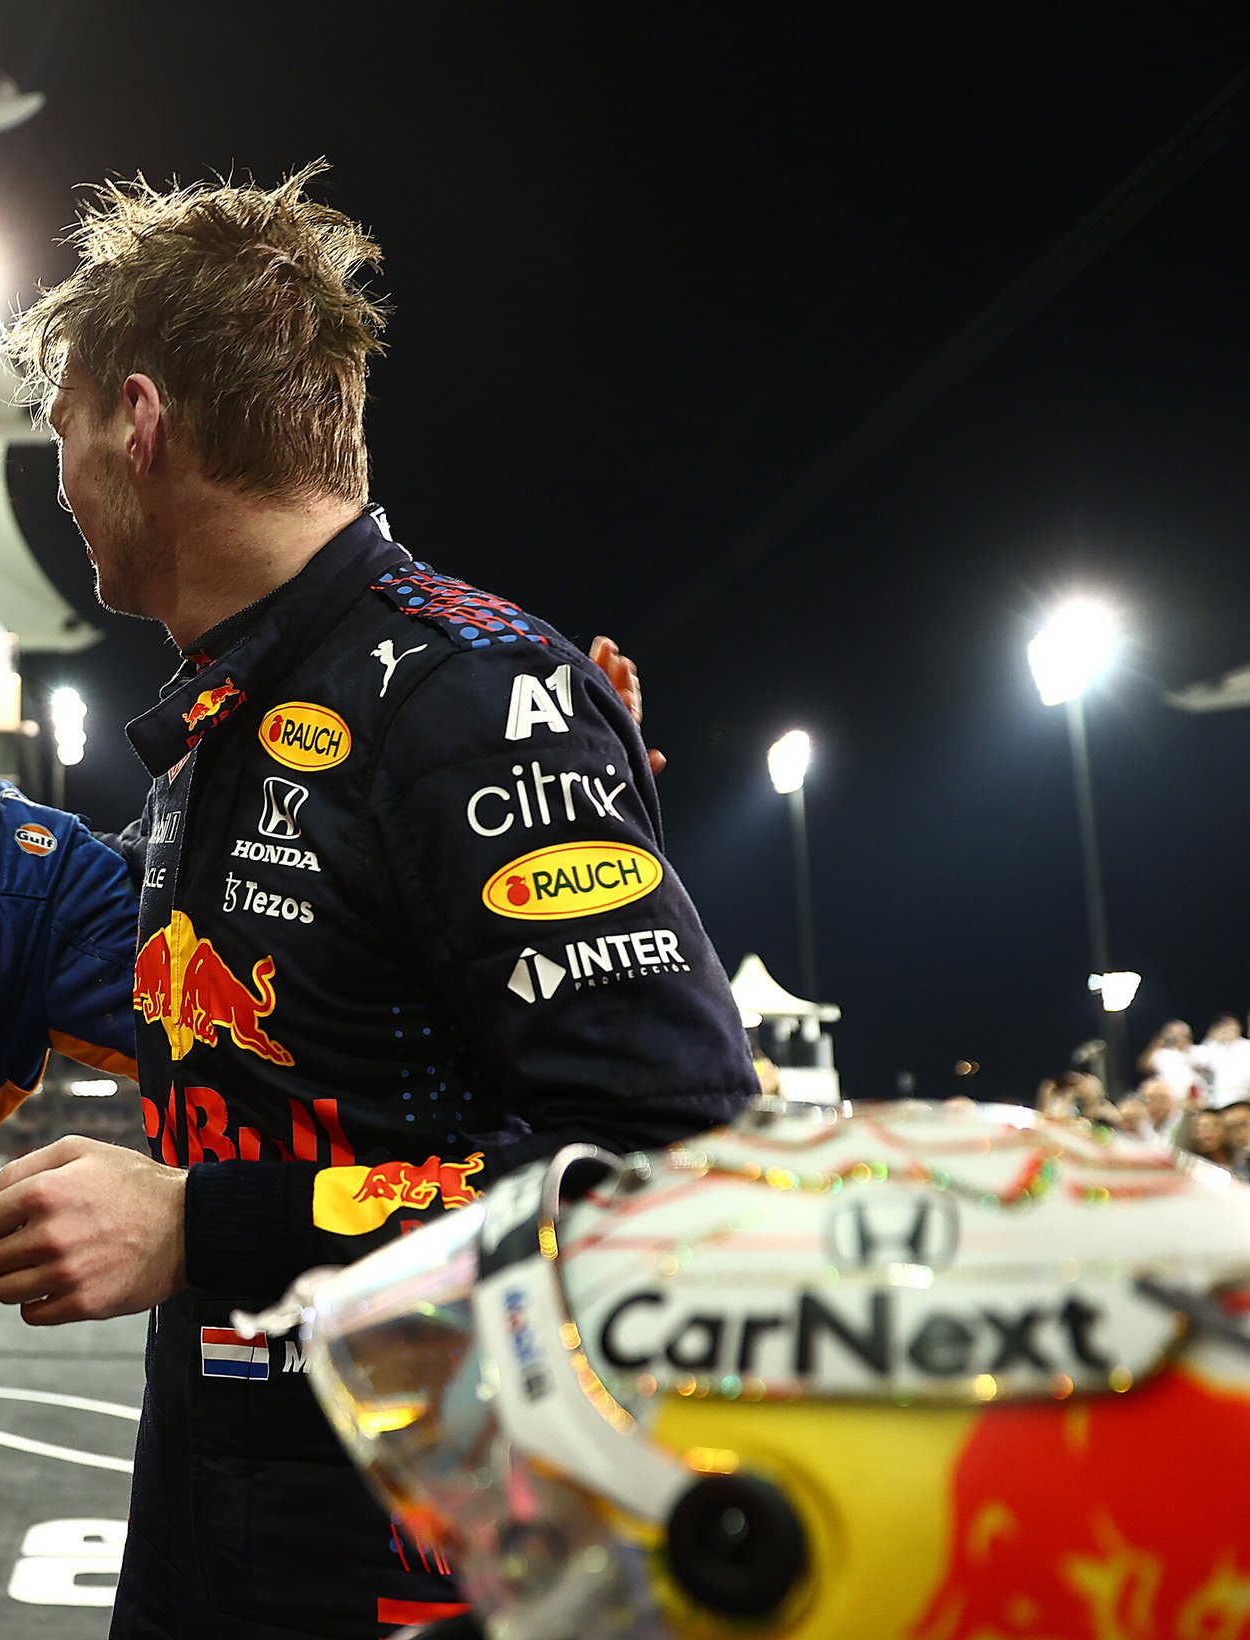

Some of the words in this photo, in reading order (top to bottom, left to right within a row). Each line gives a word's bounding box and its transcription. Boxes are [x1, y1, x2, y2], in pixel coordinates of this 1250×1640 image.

[505, 664, 574, 740] A1
[281, 719, 343, 757] RAUCH
[467, 761, 626, 837] citrix
[16, 830, 53, 849] Gulf
[231, 840, 321, 872] HONDA
[533, 858, 642, 900] RAUCH
[243, 881, 314, 924] Tezos
[565, 929, 686, 979] INTER
[600, 1290, 1115, 1380] CarNext
